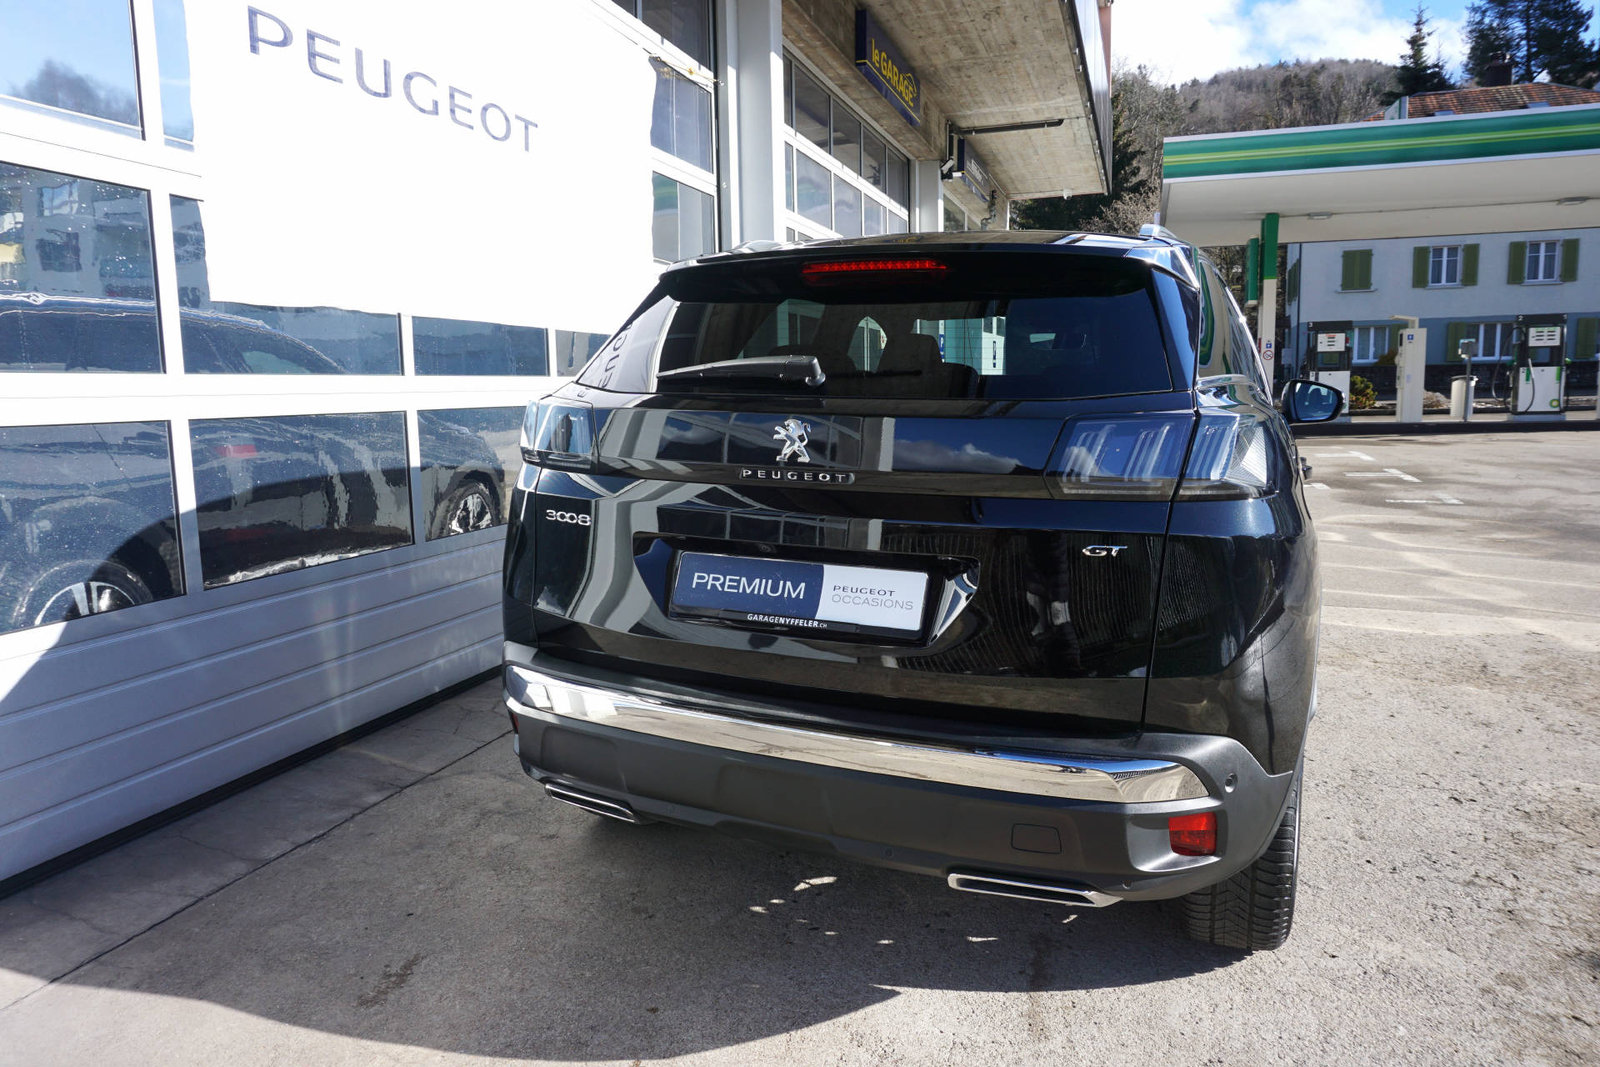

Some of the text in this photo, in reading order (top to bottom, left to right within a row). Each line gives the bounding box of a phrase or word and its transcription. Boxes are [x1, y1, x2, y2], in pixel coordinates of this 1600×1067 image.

[247, 5, 538, 152] PEUGEOT
[871, 38, 914, 107] le GARAGE
[742, 469, 846, 482] PEUGEOT
[545, 509, 592, 526] 3008
[1082, 545, 1128, 557] GT
[692, 572, 806, 600] PREMIUM
[832, 585, 896, 597] PEUGEOT
[831, 593, 914, 611] OCCASIONS
